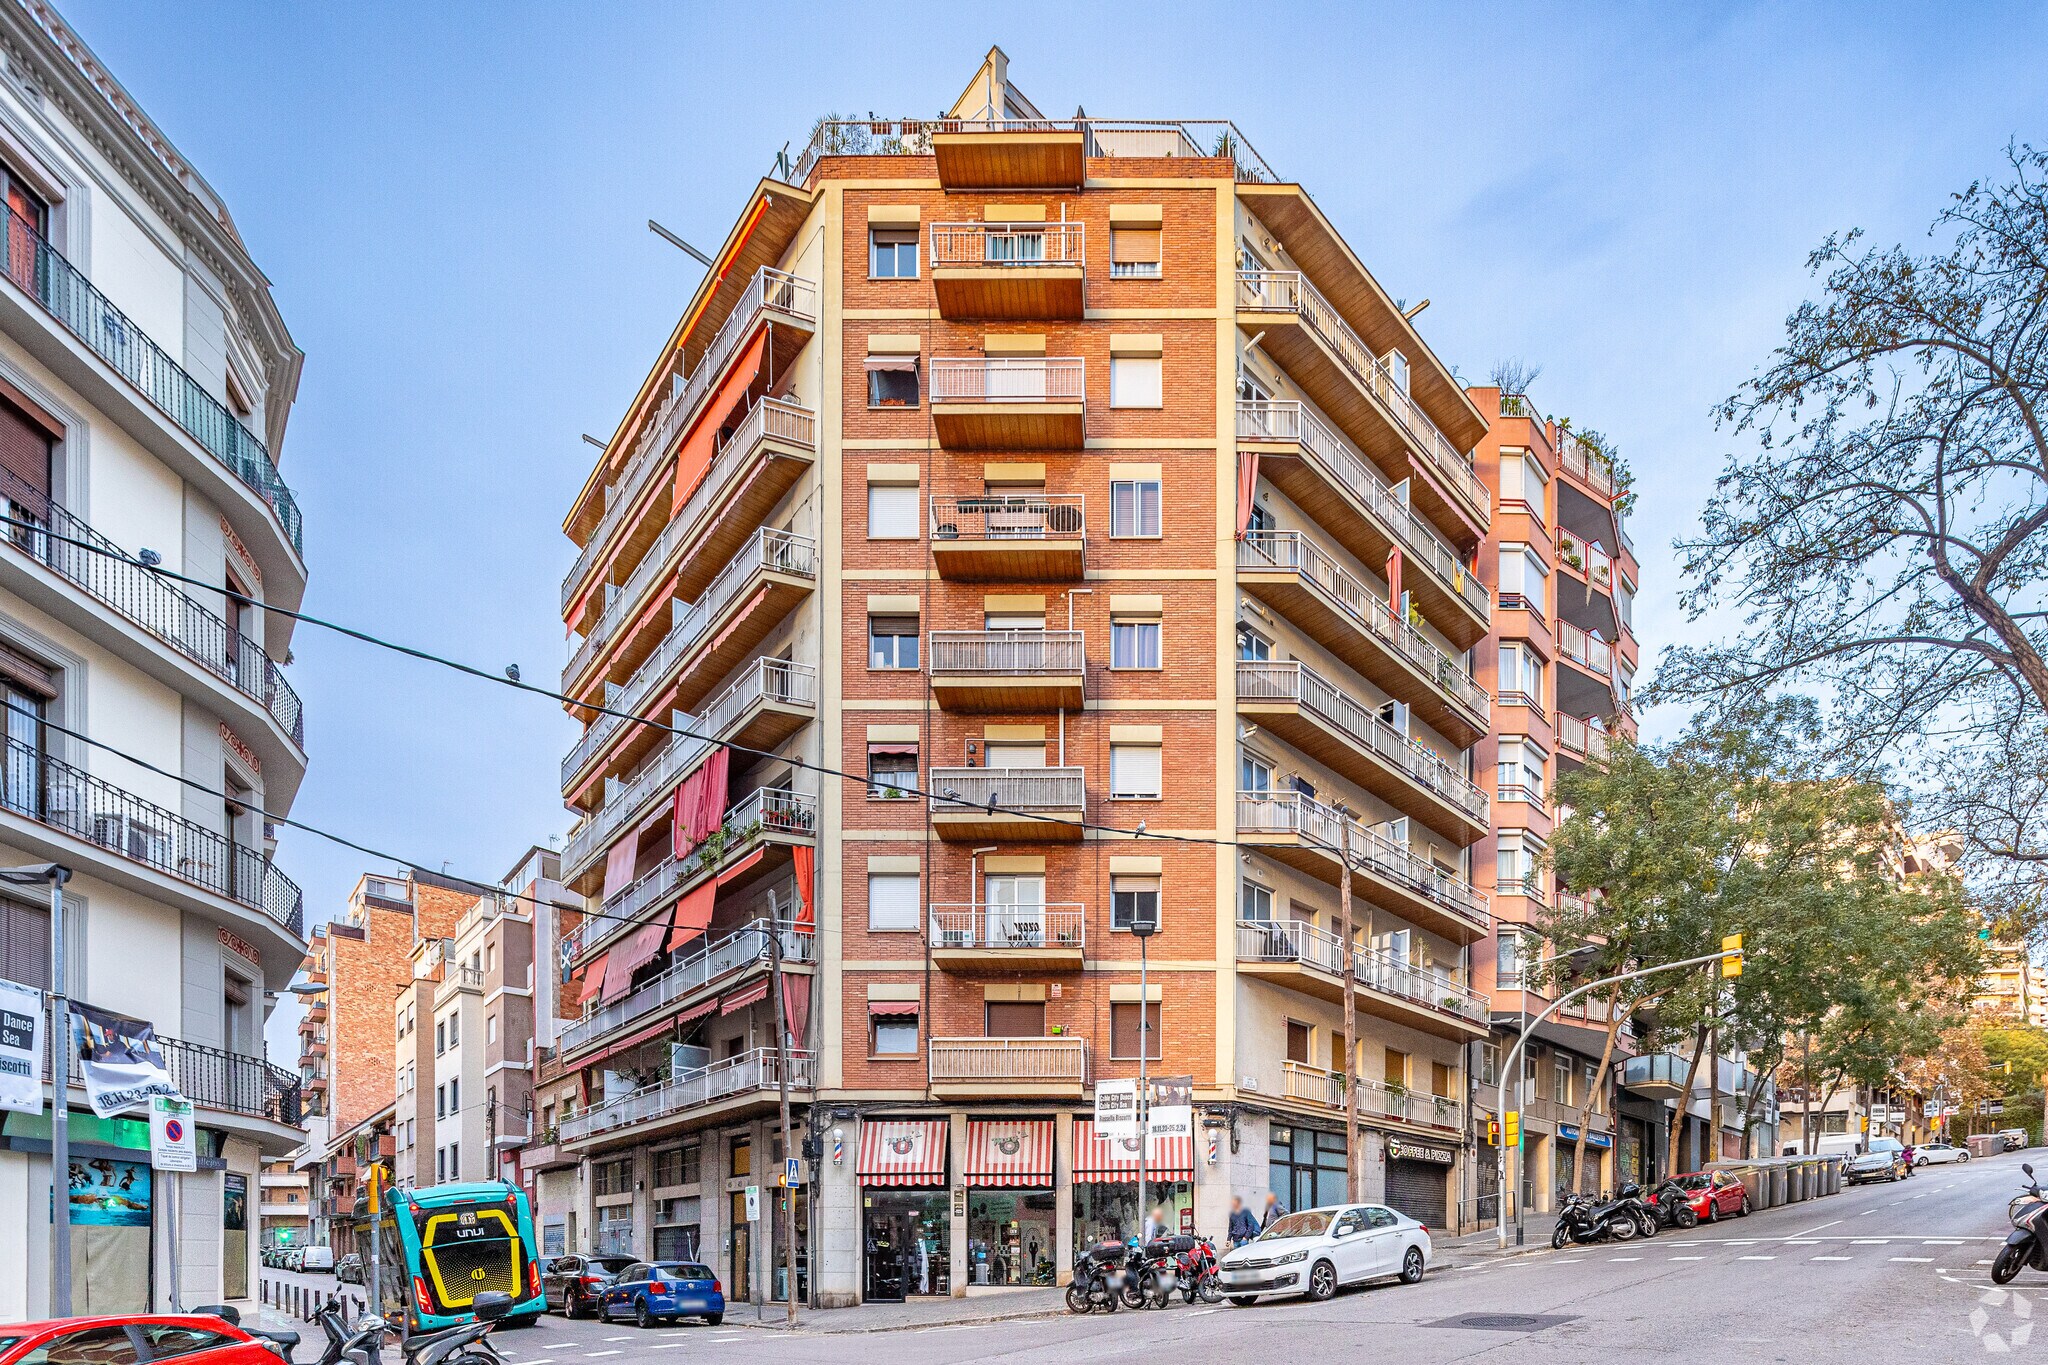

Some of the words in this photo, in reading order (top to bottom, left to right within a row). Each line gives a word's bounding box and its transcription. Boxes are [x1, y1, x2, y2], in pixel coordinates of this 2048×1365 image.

[3, 1012, 33, 1032] Dance
[2, 1029, 20, 1046] Sea
[1425, 1148, 1431, 1159] &
[1431, 1149, 1452, 1162] PIZZA
